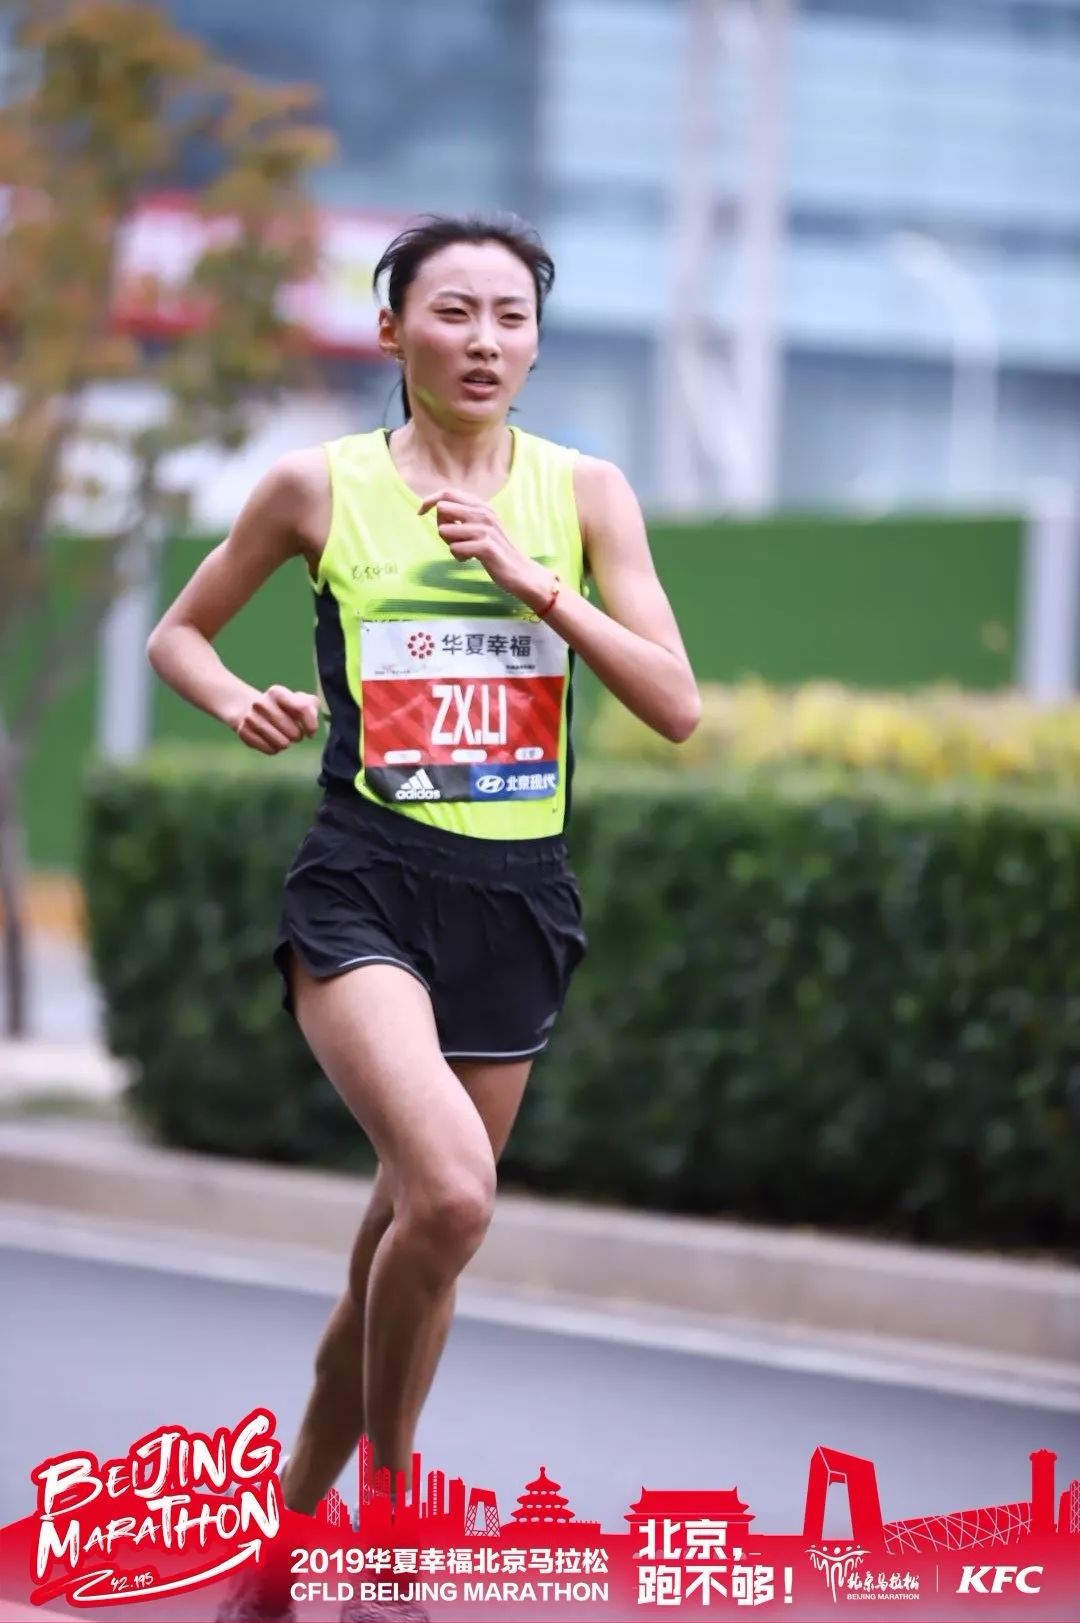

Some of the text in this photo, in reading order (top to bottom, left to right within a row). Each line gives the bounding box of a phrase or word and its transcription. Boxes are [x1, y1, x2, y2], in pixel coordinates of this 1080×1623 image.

[441, 633, 532, 658] 华夏幸福
[431, 684, 508, 745] ZX.LI
[506, 773, 556, 792] 北京现代
[395, 789, 441, 800] adidas
